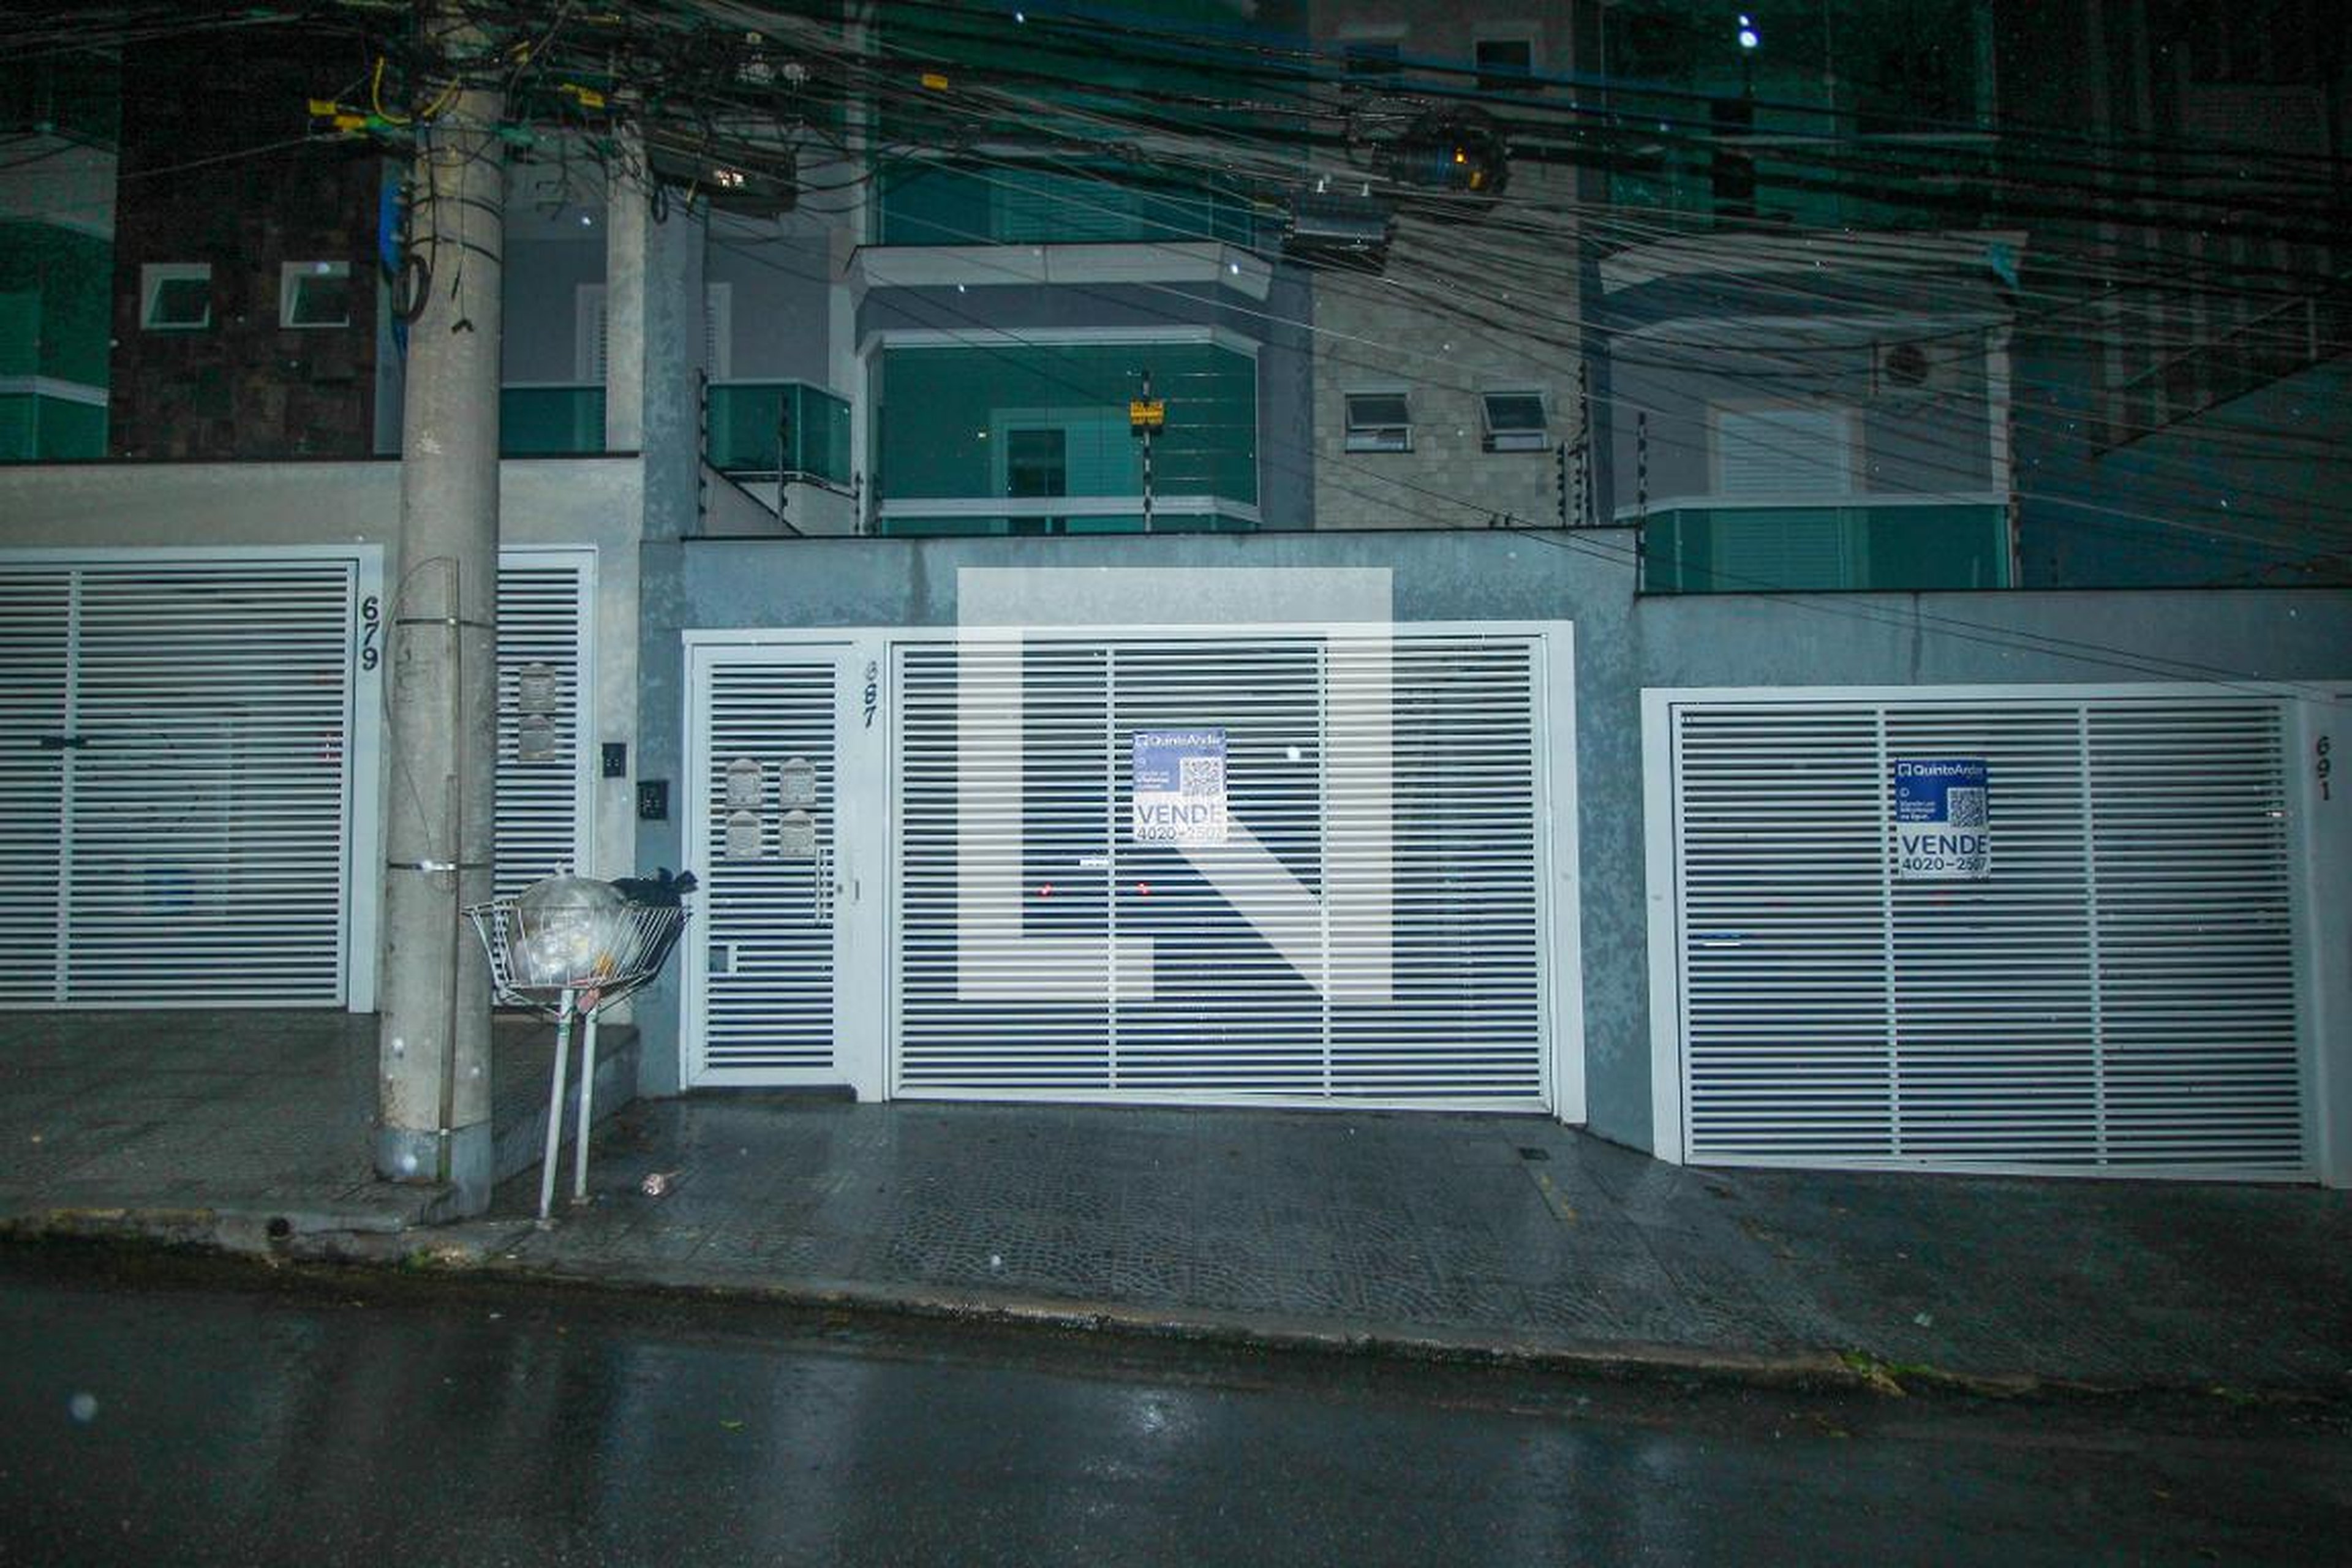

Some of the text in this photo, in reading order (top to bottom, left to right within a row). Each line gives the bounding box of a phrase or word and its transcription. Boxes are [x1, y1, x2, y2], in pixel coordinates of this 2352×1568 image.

[362, 596, 380, 671] 679
[2316, 736, 2330, 801] 691
[1137, 804, 1223, 824] VENDE
[1902, 834, 1987, 856] VENDE
